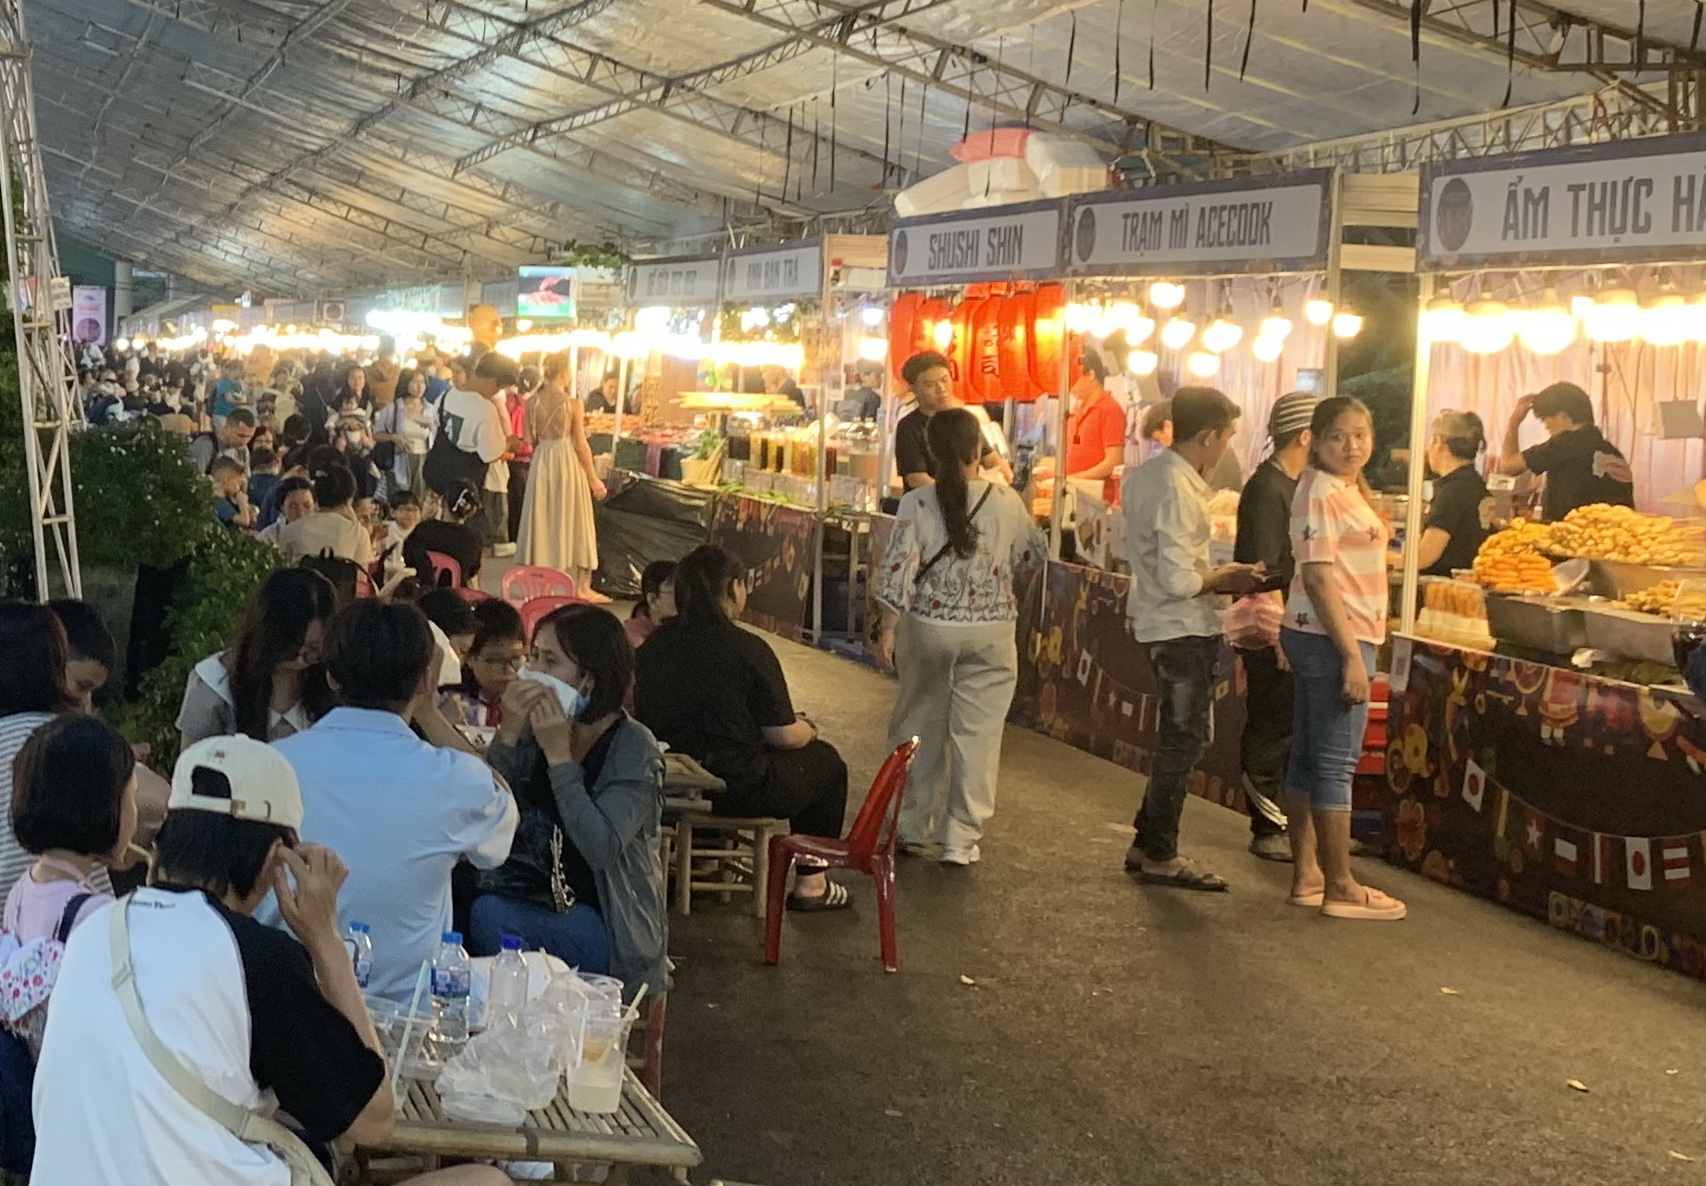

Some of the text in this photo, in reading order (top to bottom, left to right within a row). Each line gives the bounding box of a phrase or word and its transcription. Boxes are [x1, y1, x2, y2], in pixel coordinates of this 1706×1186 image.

[1122, 201, 1273, 257] TRẠM MÌ ACECOOK
[1502, 175, 1550, 241] ẨM
[1567, 176, 1654, 243] THỰC
[928, 224, 1023, 270] SHUSHI SHIN
